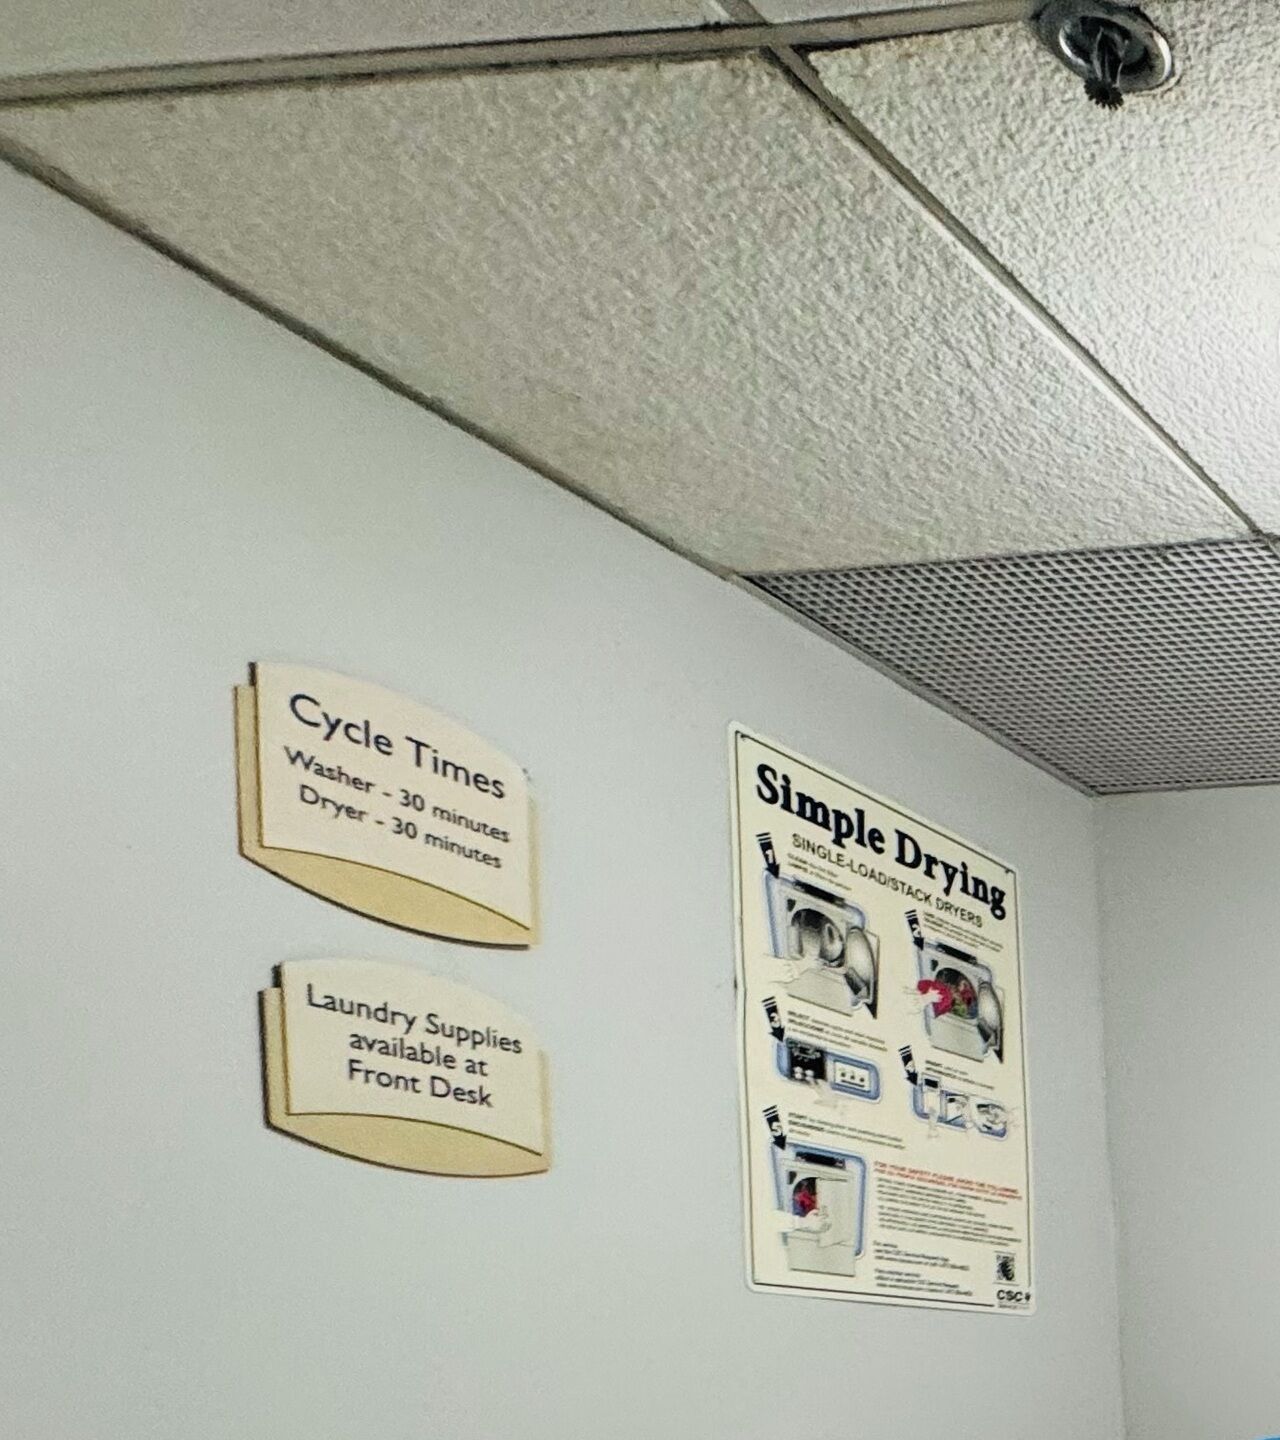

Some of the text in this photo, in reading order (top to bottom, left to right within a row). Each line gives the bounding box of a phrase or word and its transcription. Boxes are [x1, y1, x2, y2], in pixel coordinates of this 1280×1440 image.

[289, 694, 506, 799] Cycle Times
[283, 745, 376, 794] Washer
[400, 790, 425, 811] 30
[432, 804, 510, 843] minutes
[300, 784, 366, 826] Dryer
[393, 817, 418, 839] 30
[425, 831, 502, 868] minutes
[756, 763, 886, 855] Simple
[895, 829, 1006, 921] Drying
[935, 897, 983, 928] DRYERS
[307, 983, 522, 1054] Laundry Supplies
[349, 1029, 488, 1076] available at
[348, 1059, 493, 1108] Front Desk
[996, 1290, 1023, 1302] CSC
